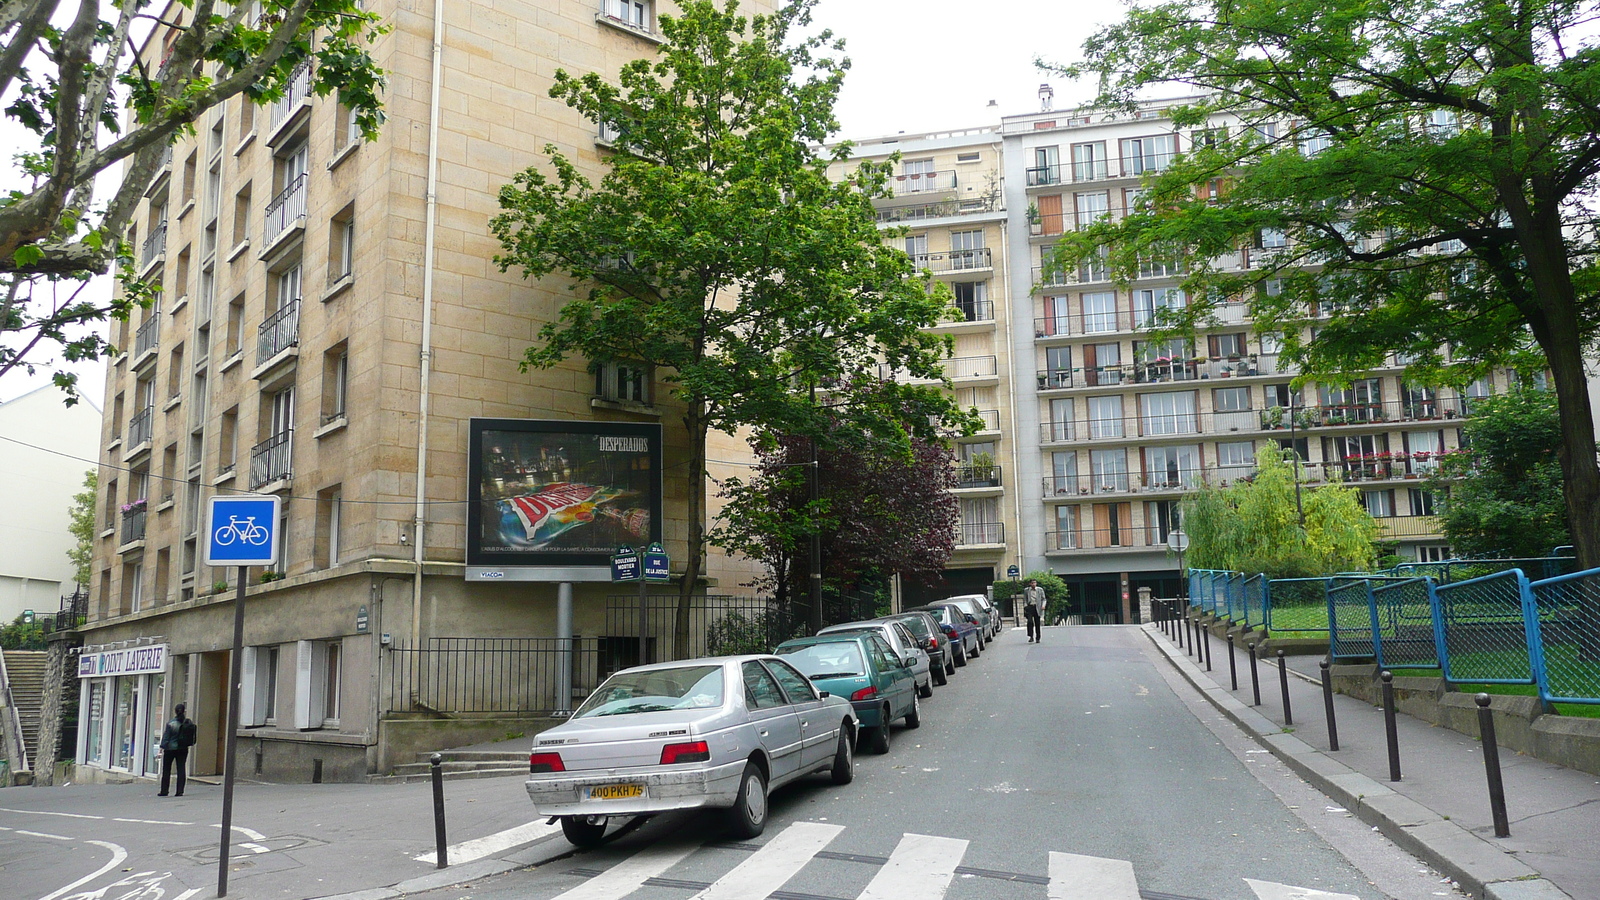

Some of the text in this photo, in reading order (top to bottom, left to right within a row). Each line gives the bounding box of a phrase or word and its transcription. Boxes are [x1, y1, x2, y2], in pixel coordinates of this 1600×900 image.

[599, 436, 649, 452] DESPERADOS
[615, 557, 636, 565] BOULEVARD
[99, 653, 123, 675] POINT
[125, 648, 162, 671] LAVERIE
[591, 784, 643, 798] 400 PKH 75
